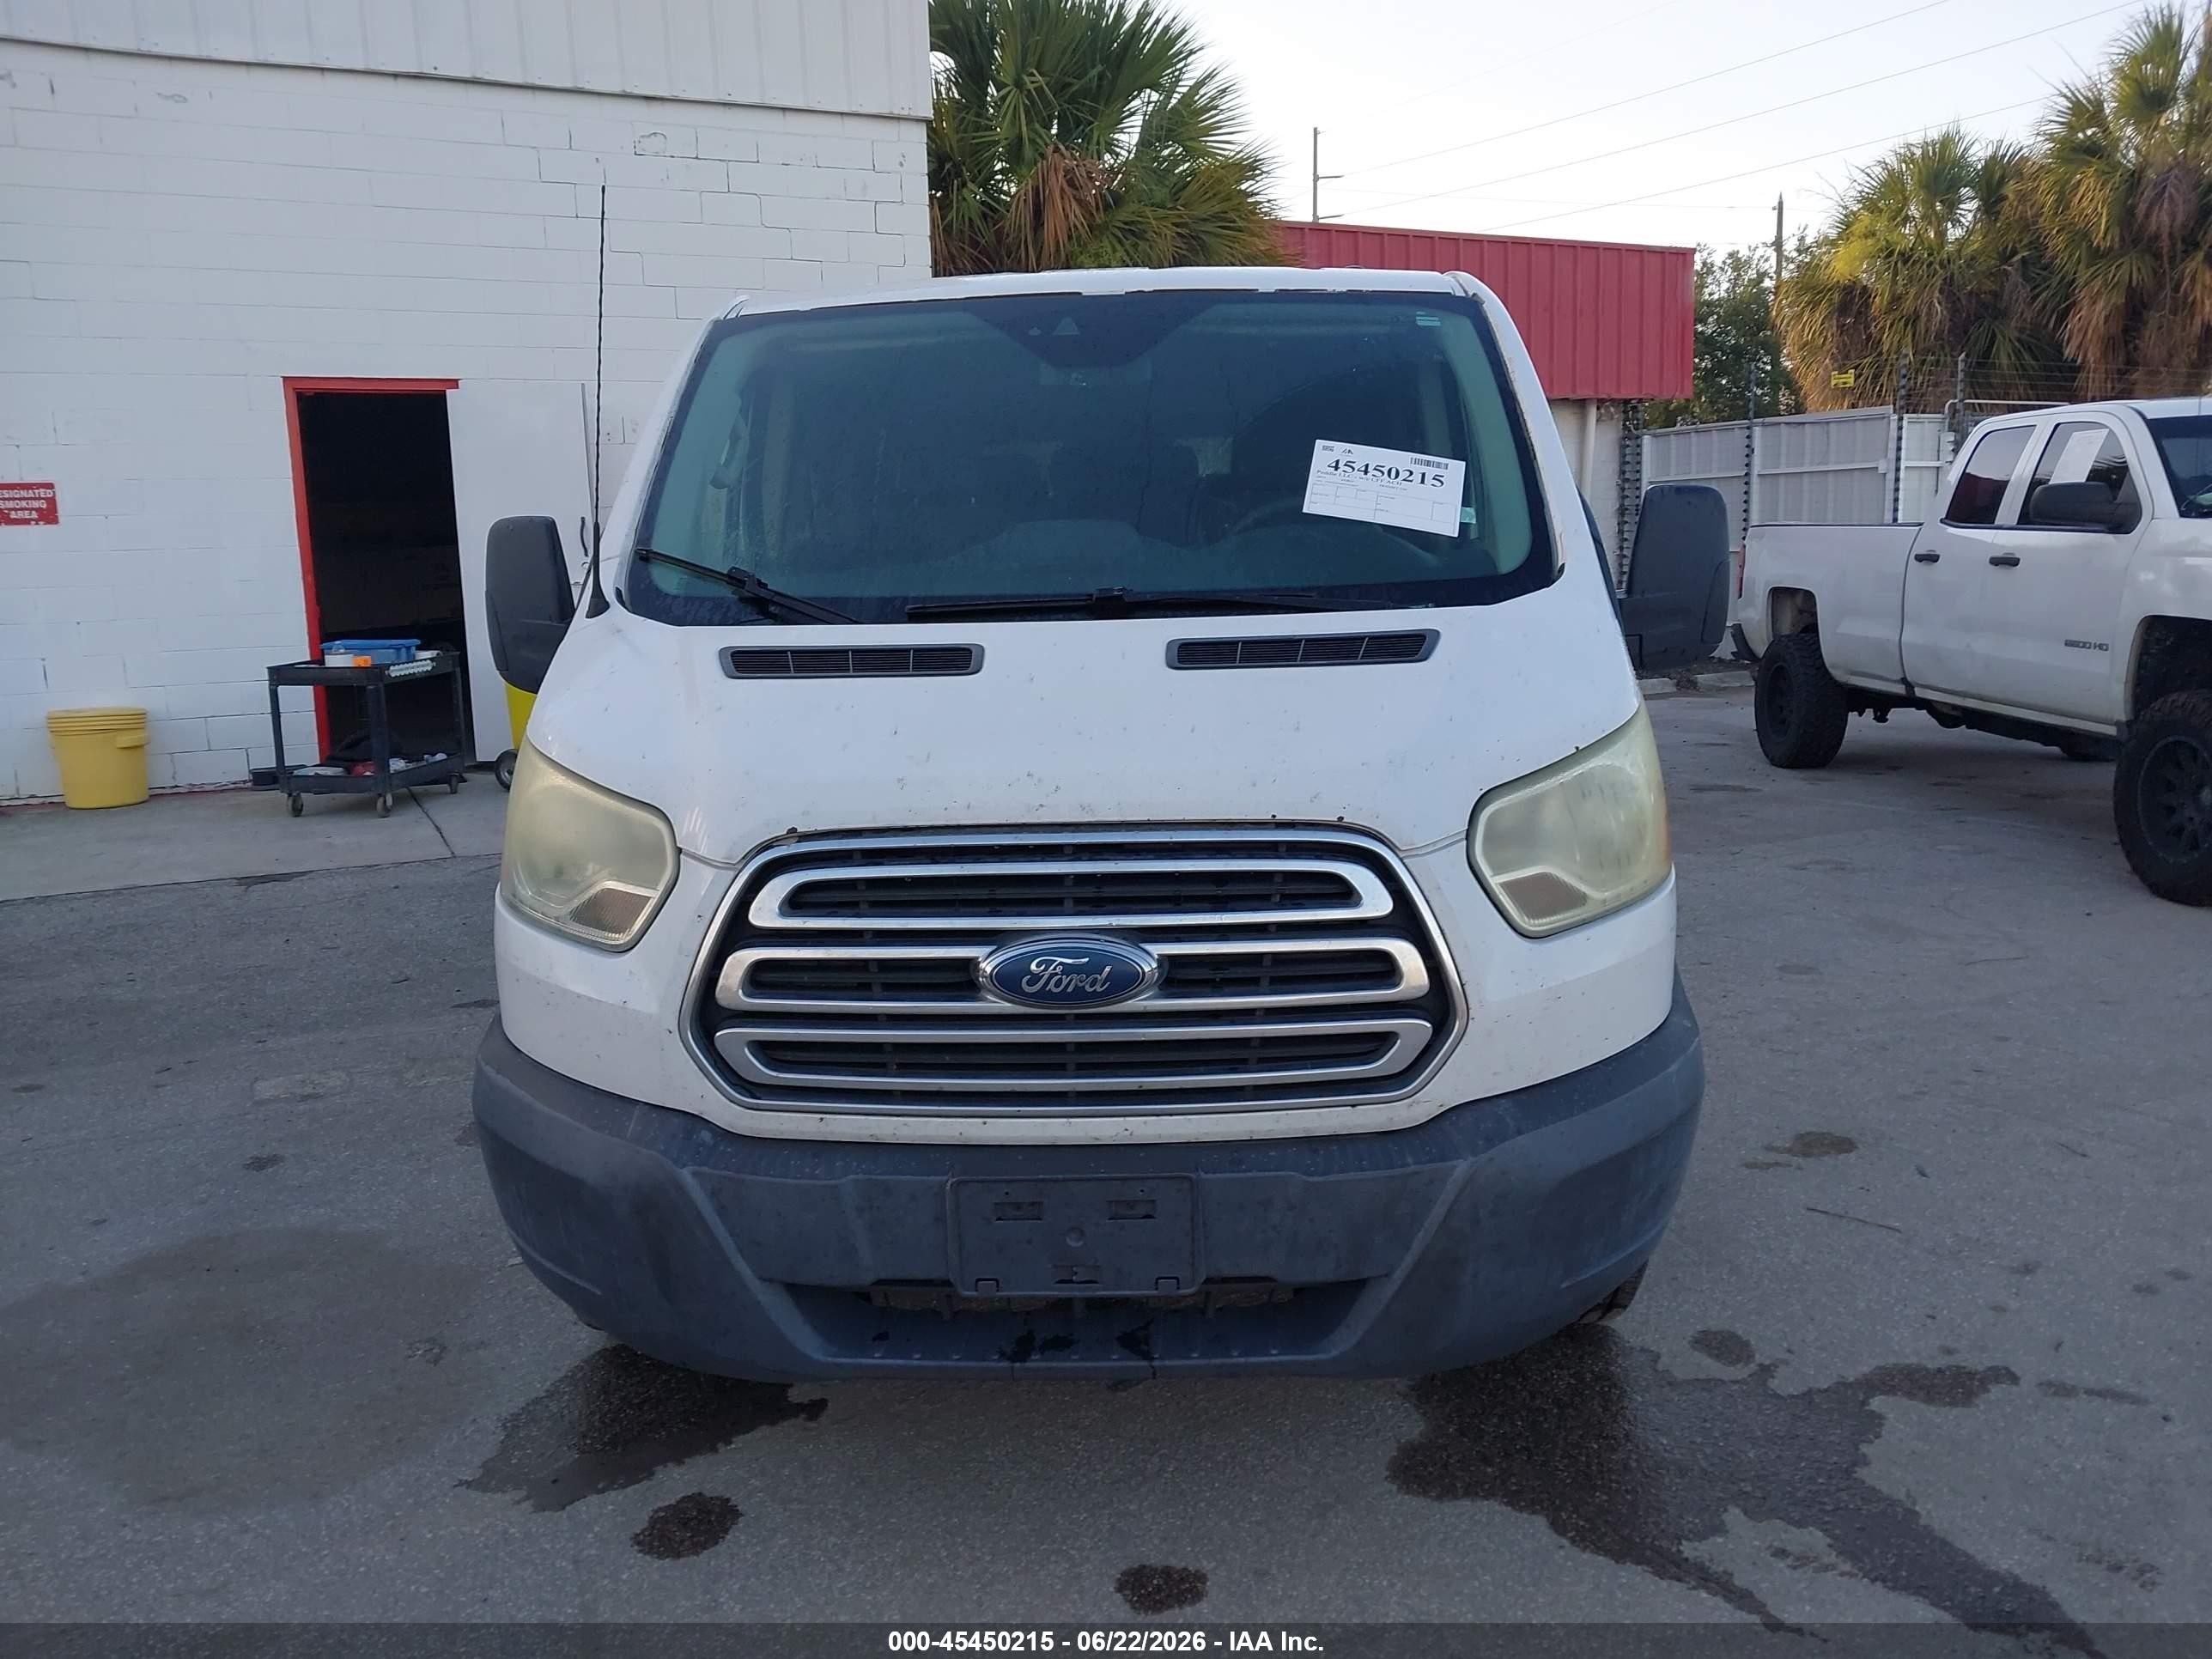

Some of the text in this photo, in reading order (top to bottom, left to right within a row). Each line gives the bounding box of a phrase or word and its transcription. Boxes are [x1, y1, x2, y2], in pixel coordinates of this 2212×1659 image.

[1327, 459, 1445, 488] 45450215
[0, 500, 47, 508] SMOKING
[9, 510, 39, 519] AREA
[1021, 956, 1113, 994] Ford
